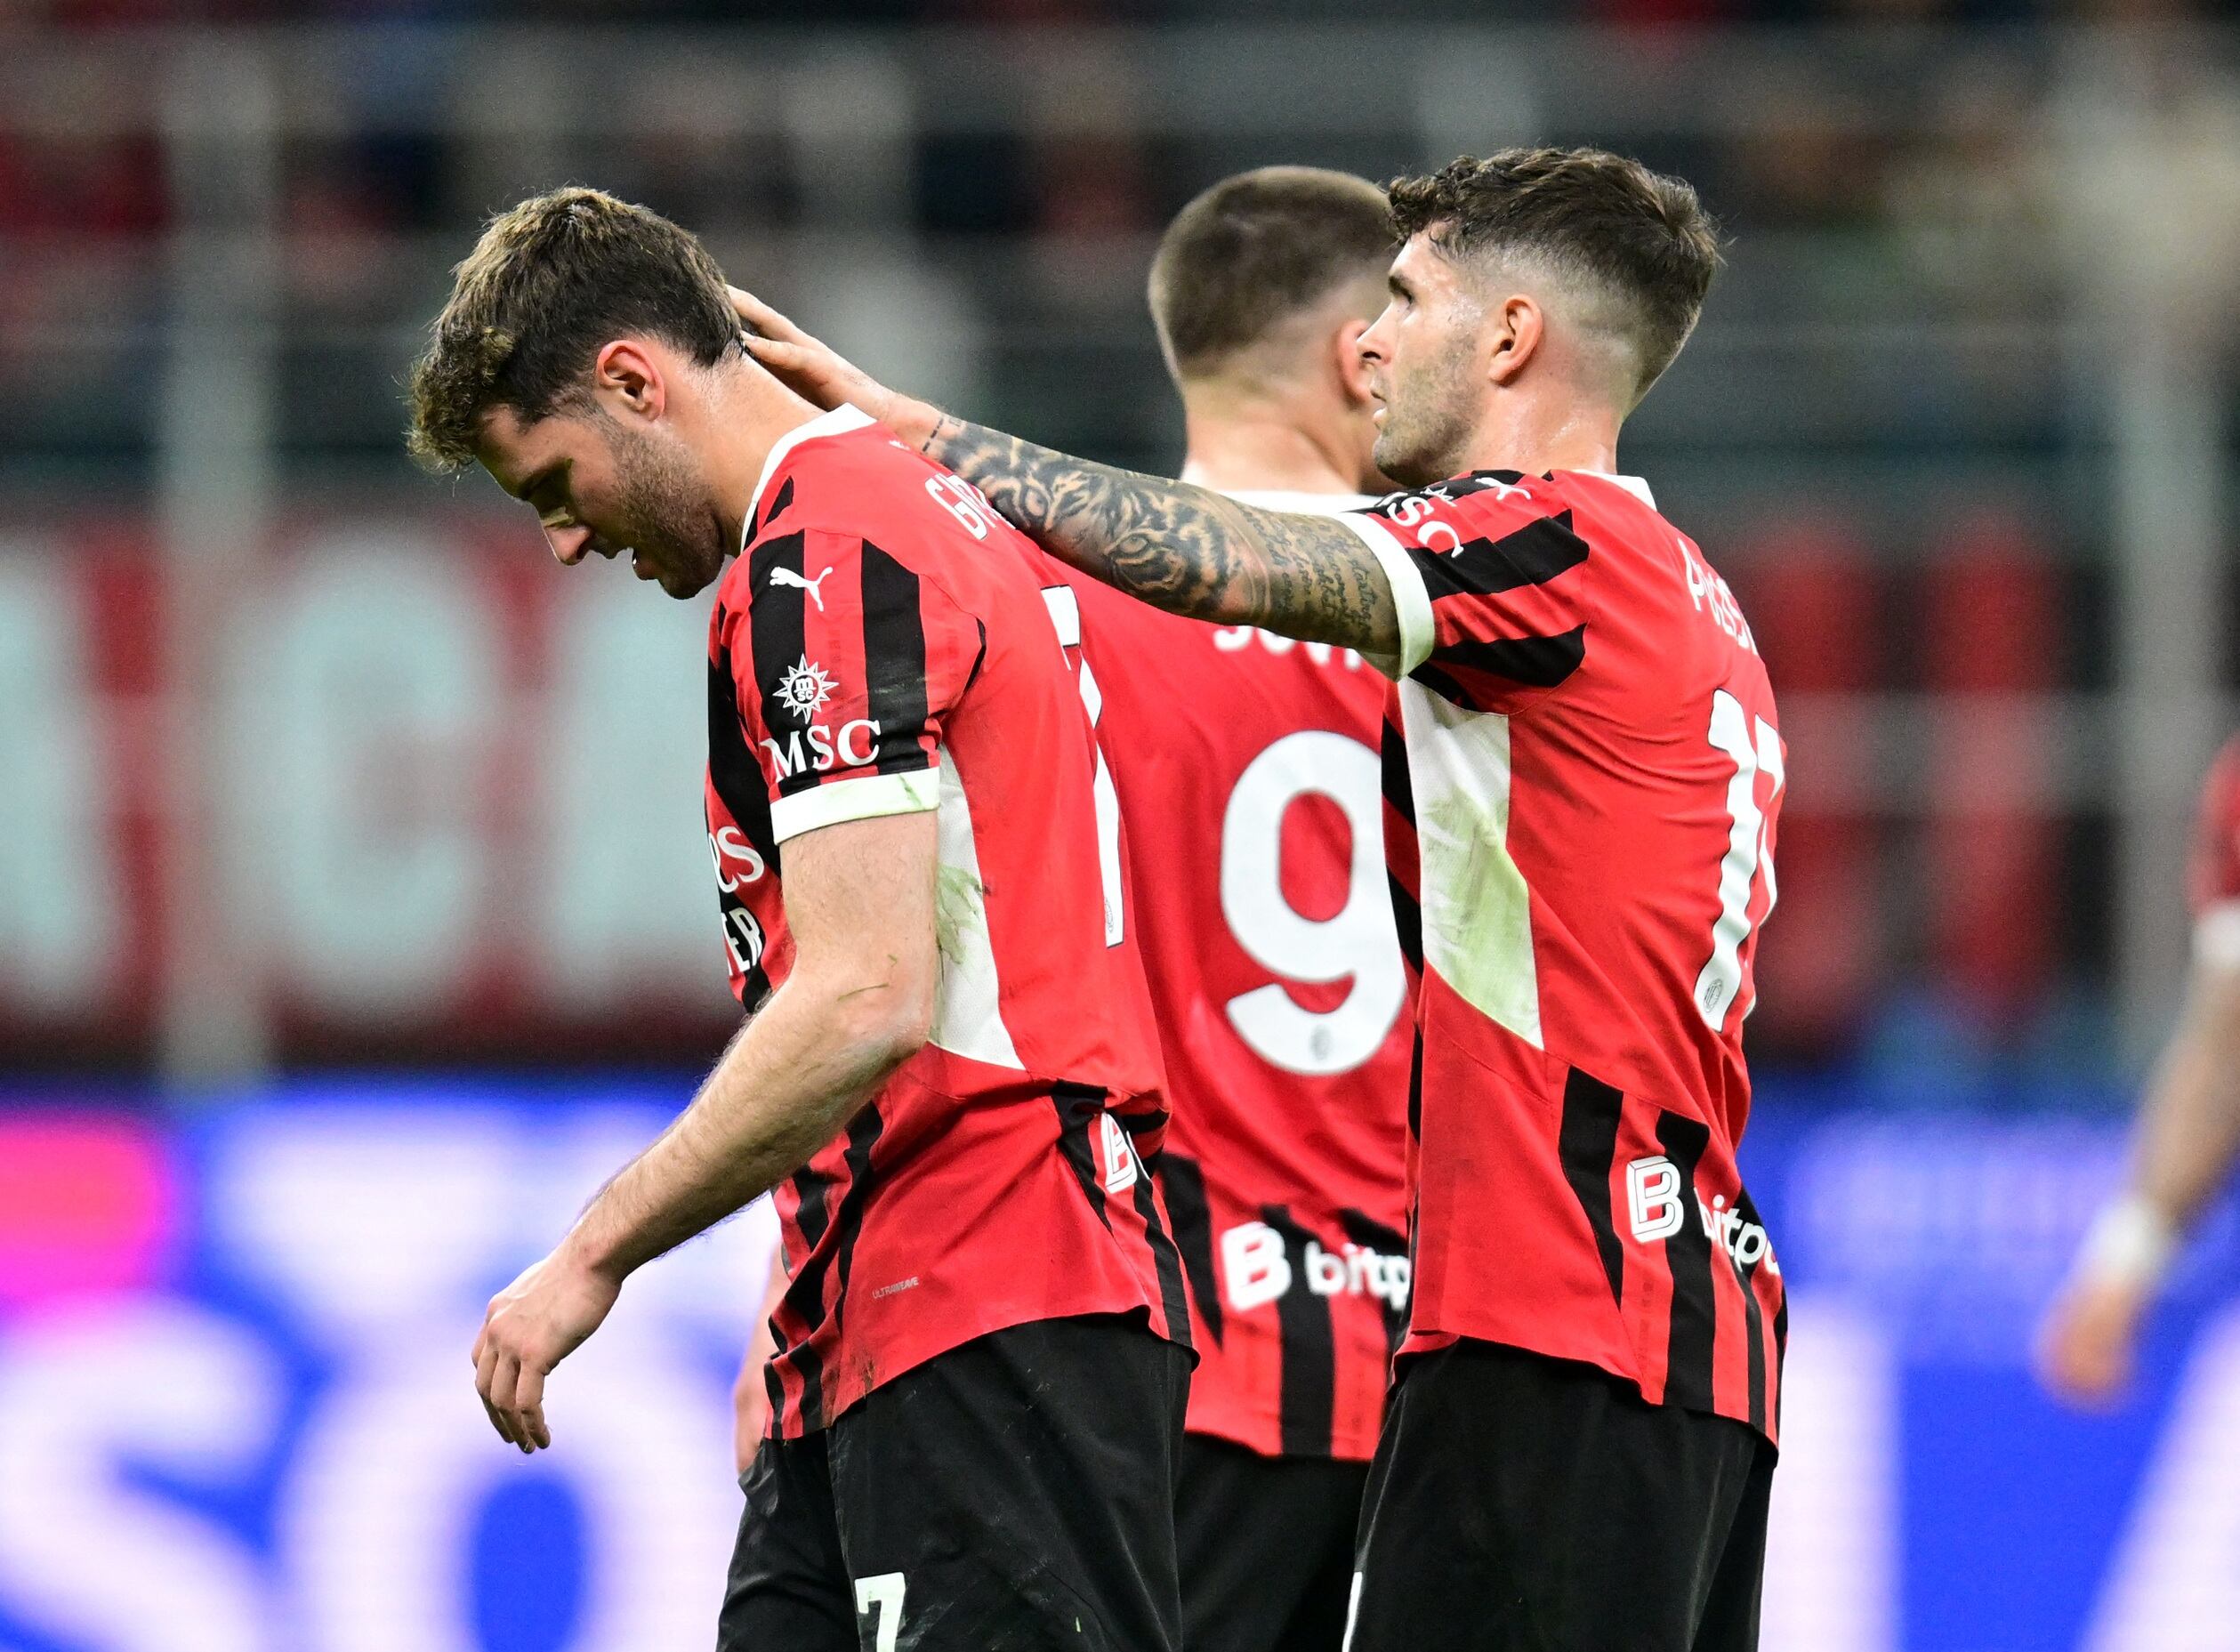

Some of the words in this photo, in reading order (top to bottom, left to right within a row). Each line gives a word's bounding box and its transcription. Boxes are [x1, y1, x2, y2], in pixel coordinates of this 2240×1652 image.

[760, 719, 882, 783] MSC
[1220, 730, 1408, 1076] 9
[1626, 1156, 1684, 1244] B
[1221, 1221, 1291, 1311] B
[854, 1571, 906, 1652] 7
